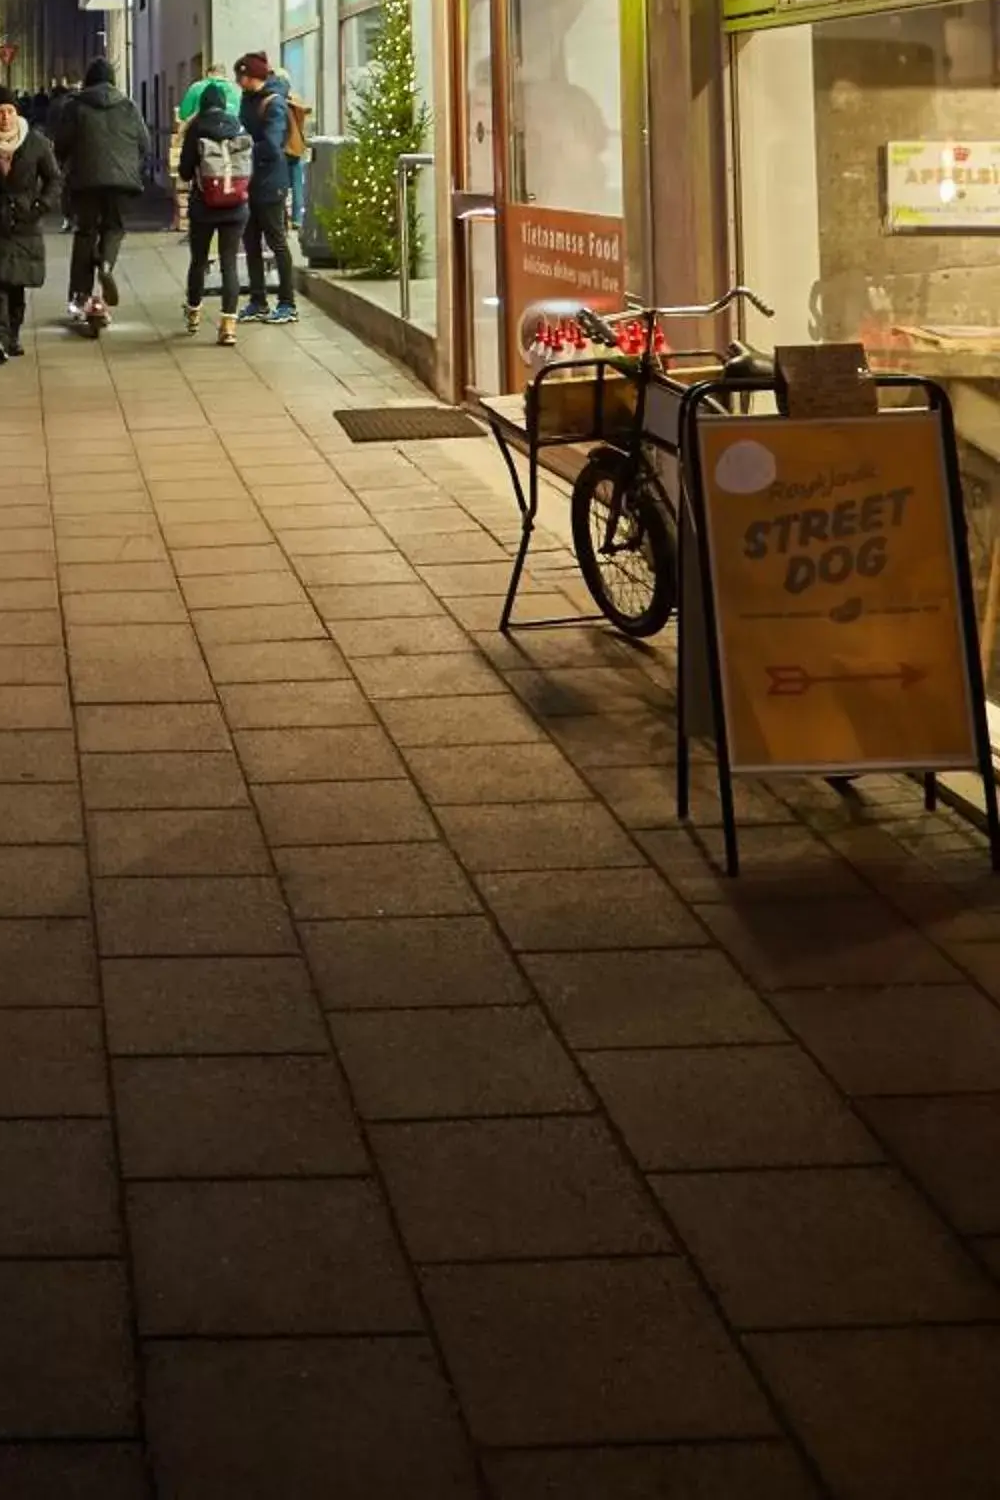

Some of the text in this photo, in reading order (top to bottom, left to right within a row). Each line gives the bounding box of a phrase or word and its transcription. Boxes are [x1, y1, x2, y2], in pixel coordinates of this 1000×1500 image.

[520, 220, 620, 262] Vietnamese Food
[743, 486, 915, 561] STREET
[783, 535, 890, 595] DOG
